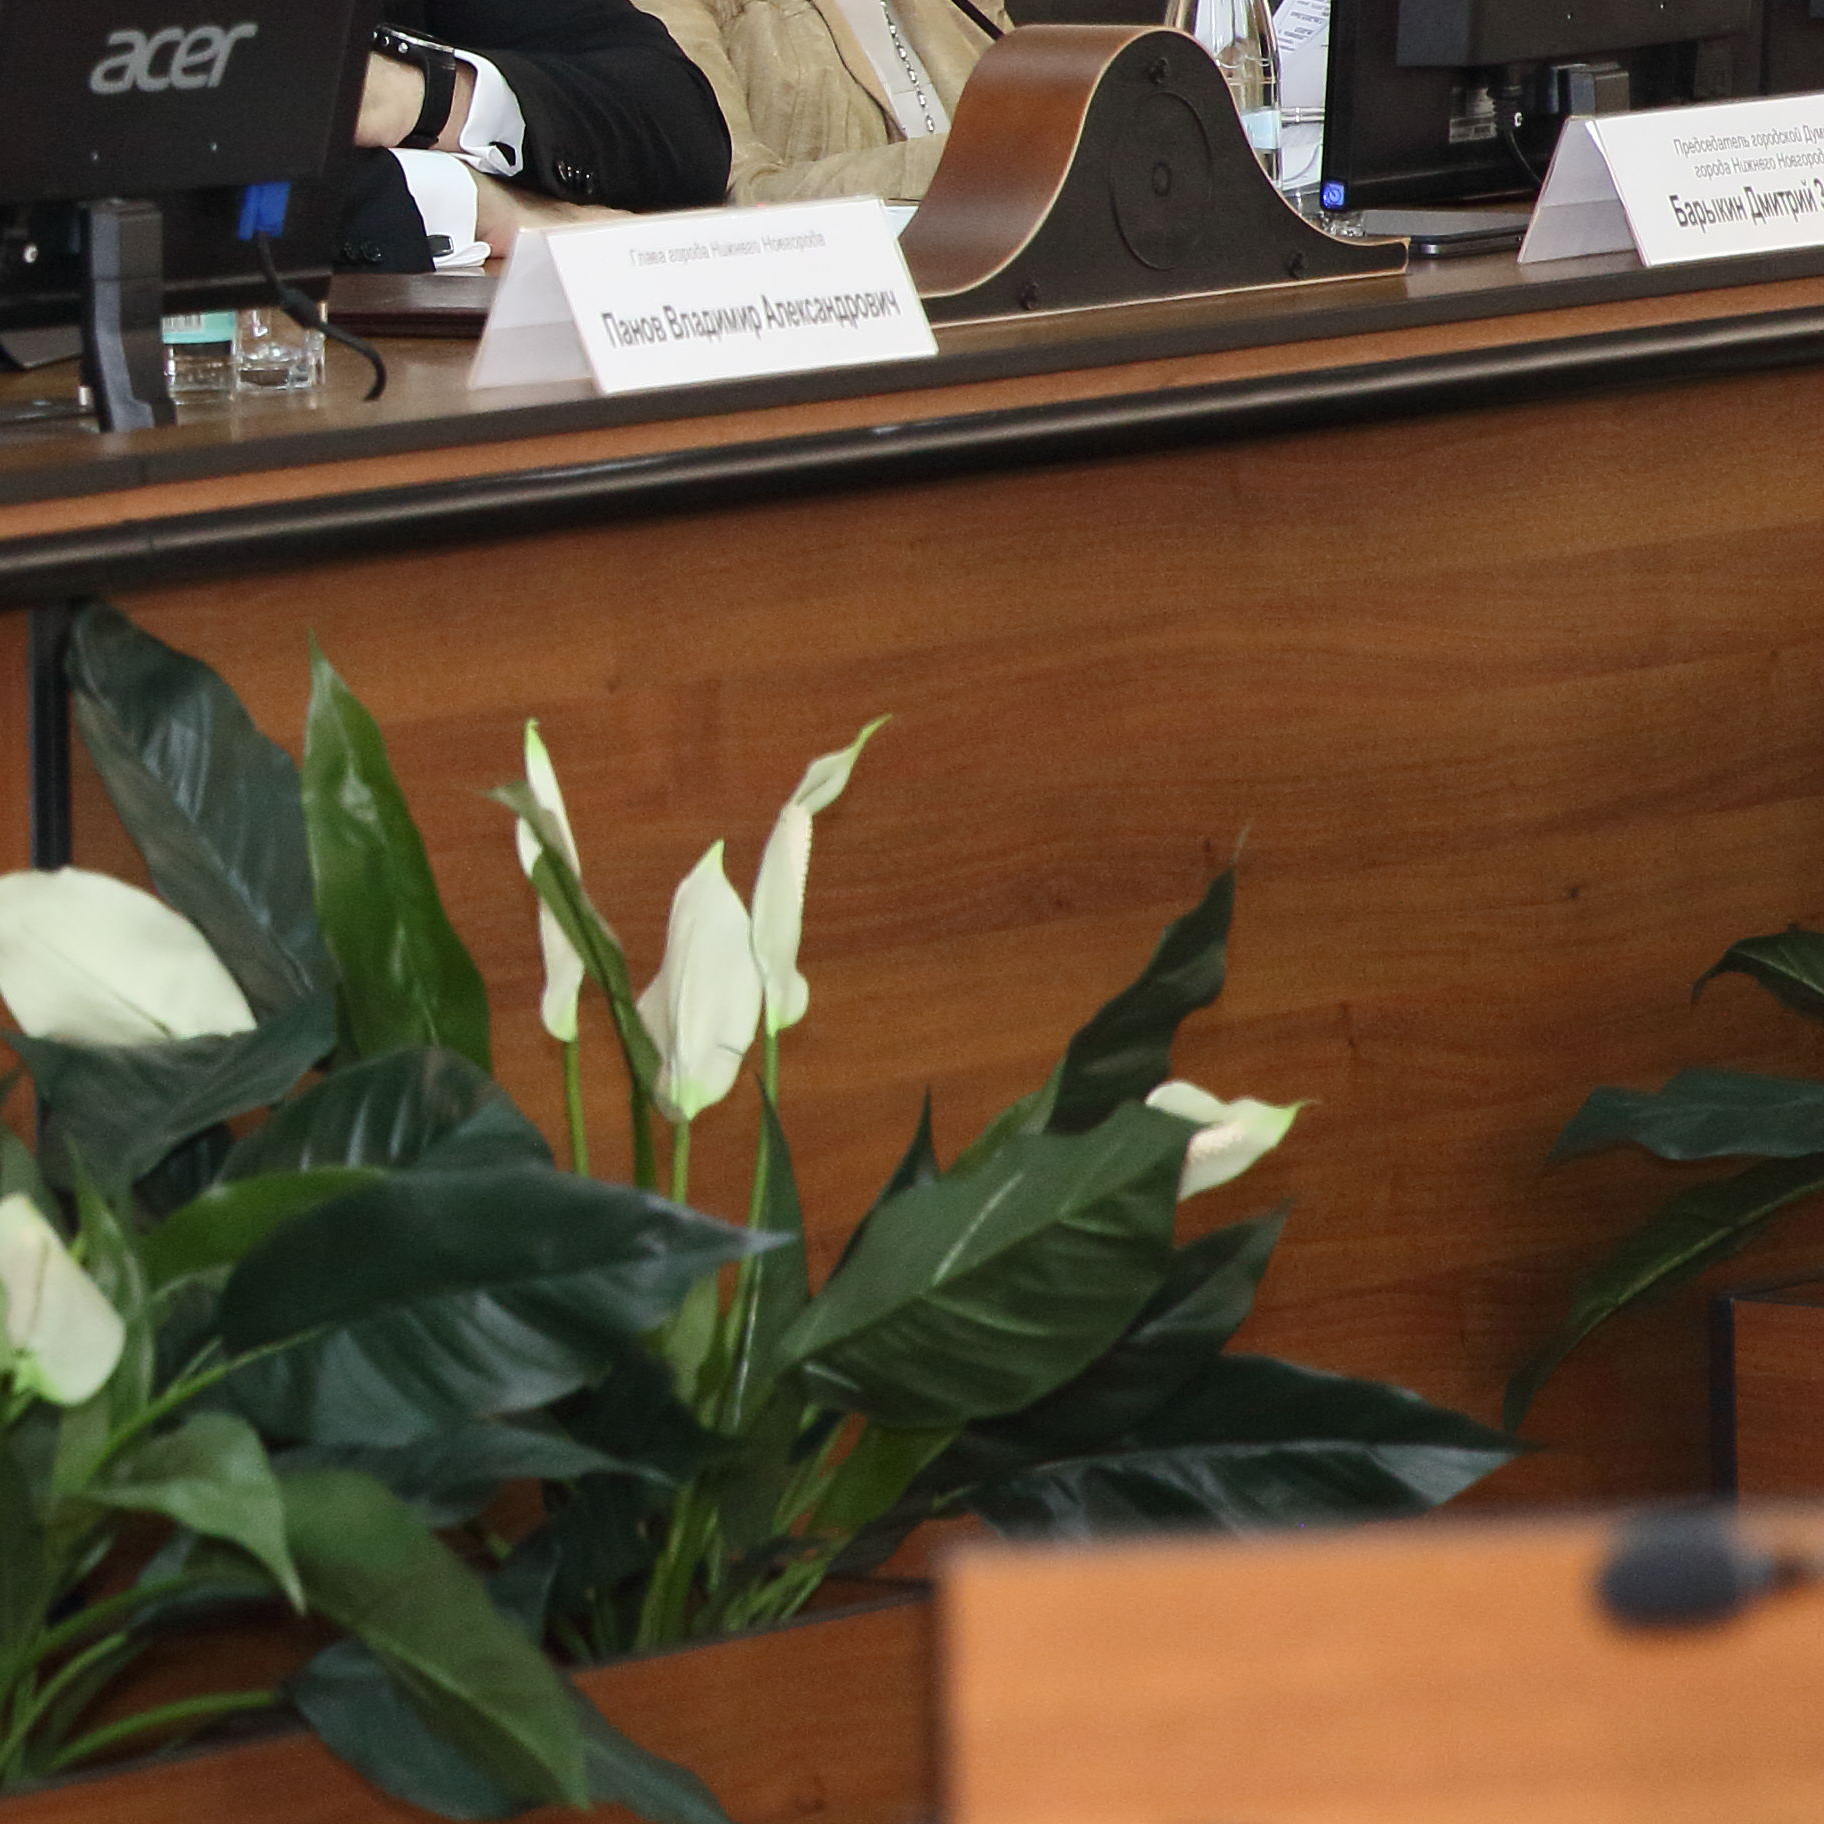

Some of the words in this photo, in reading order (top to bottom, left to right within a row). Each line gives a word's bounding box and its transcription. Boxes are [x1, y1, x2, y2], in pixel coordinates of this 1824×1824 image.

[88, 22, 259, 95] acer
[1672, 134, 1750, 159] Председатель
[1751, 127, 1802, 150] городской
[1694, 159, 1731, 180] города
[1730, 156, 1777, 174] Нижнего
[1668, 192, 1748, 234] Барыкин
[1743, 179, 1819, 226] Дмитрий
[601, 311, 667, 349] Панов
[661, 303, 762, 343] Владимир
[759, 287, 902, 330] Александрович
